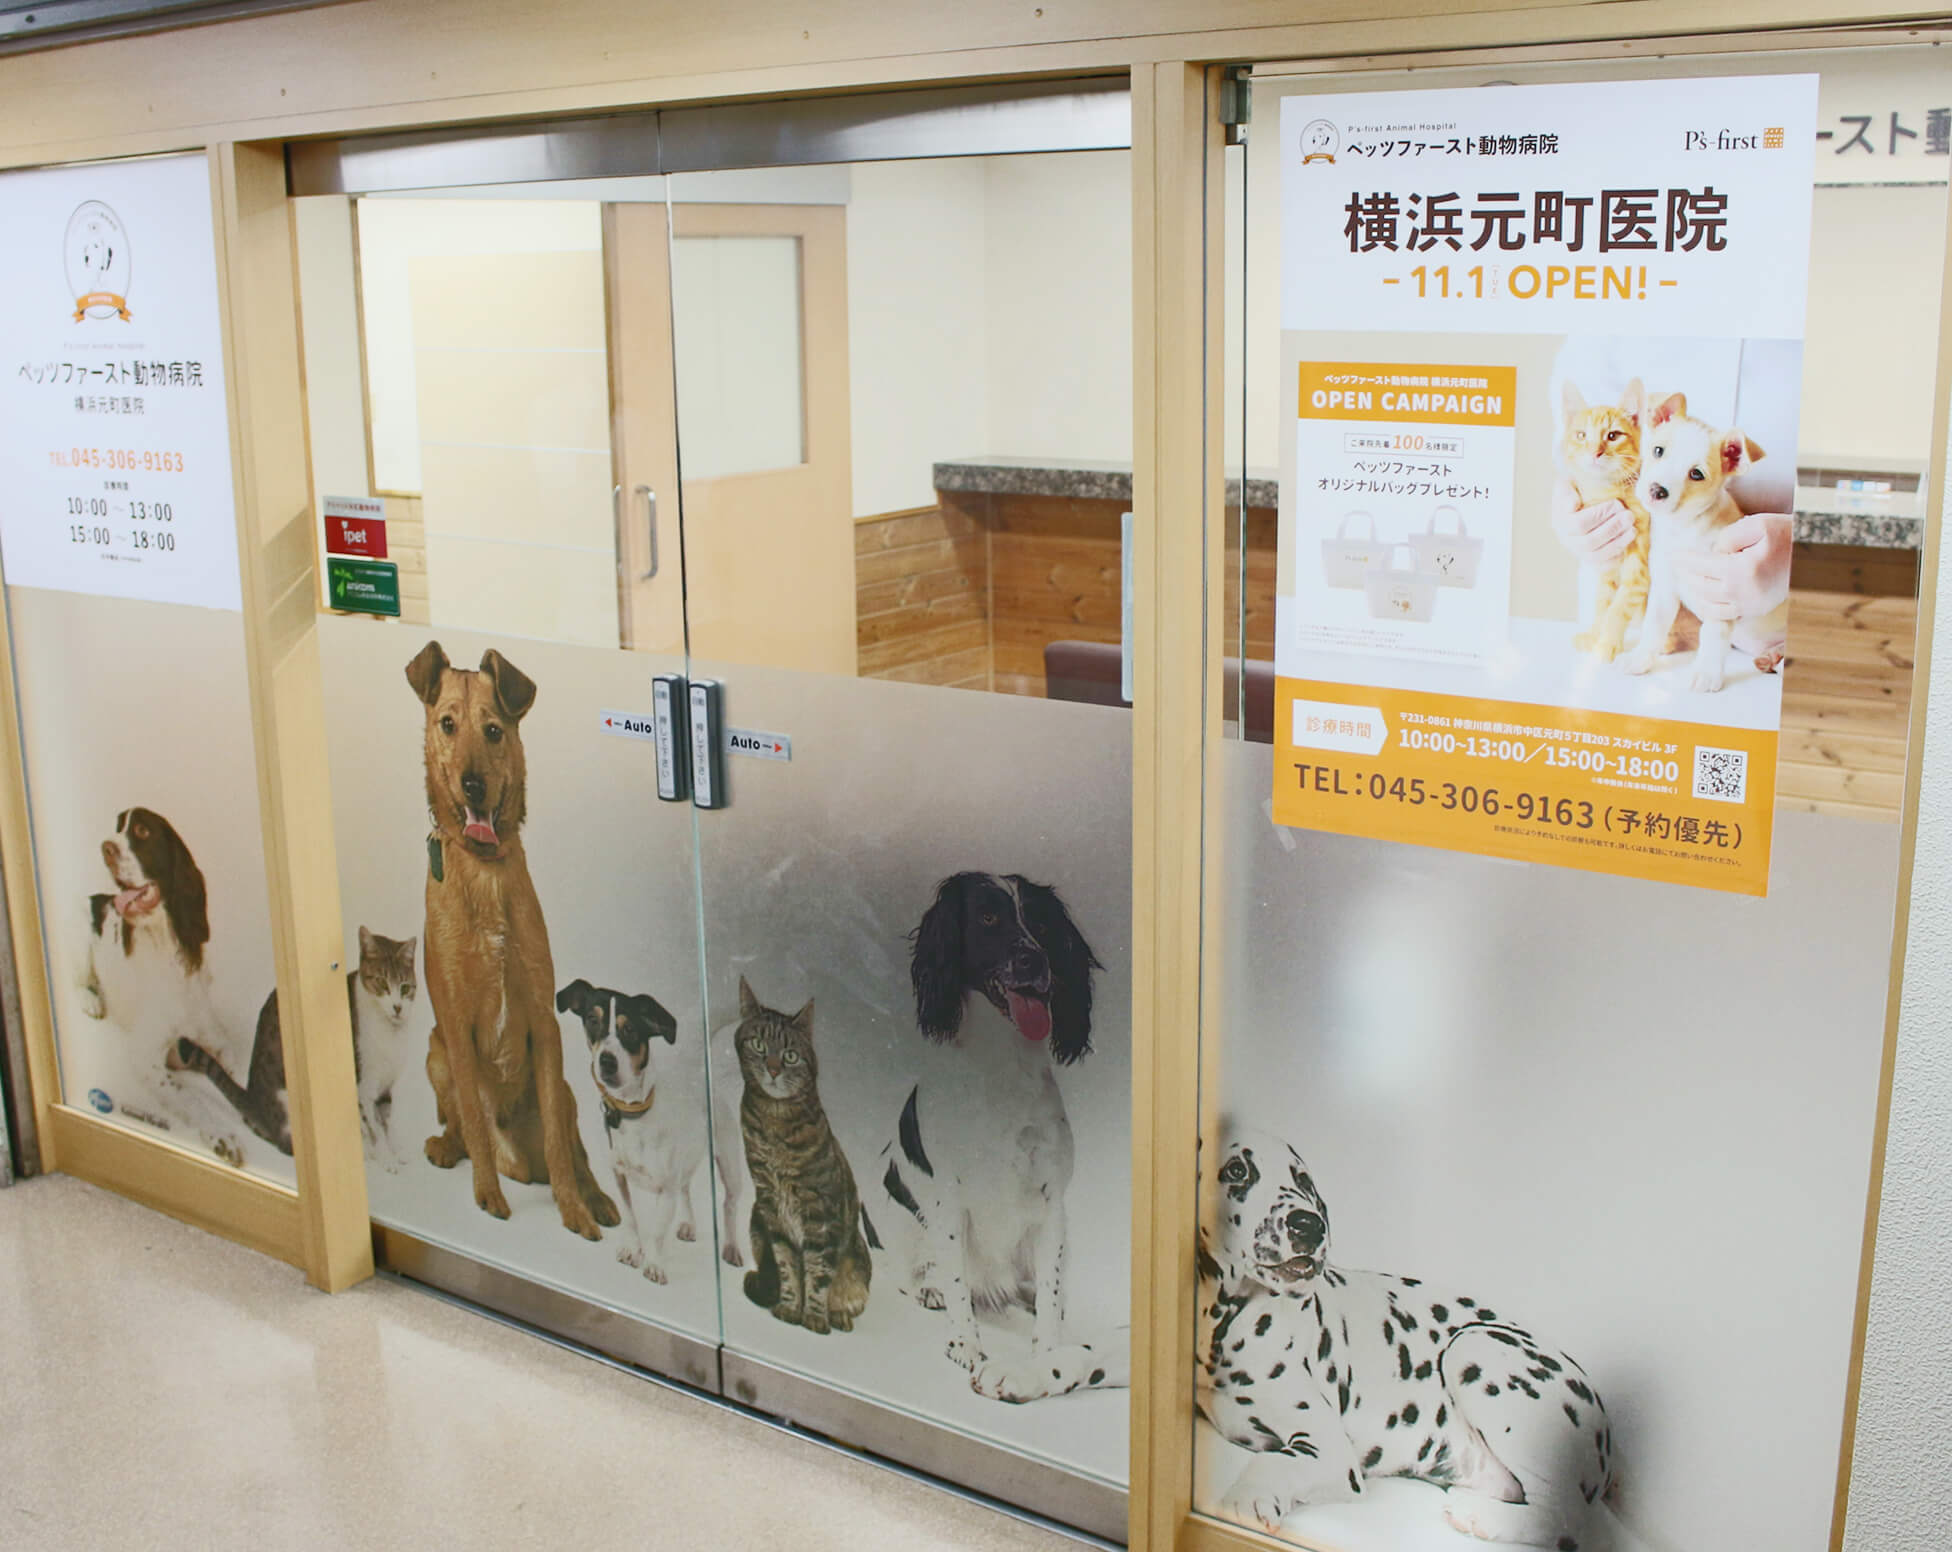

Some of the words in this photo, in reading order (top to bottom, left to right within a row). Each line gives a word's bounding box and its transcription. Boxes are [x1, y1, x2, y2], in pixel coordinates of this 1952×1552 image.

[1386, 124, 1416, 132] Animal
[1419, 122, 1457, 132] Hospital
[1347, 133, 1559, 157] ペッツファースト動物病院
[1684, 129, 1759, 150] P's-first
[1344, 186, 1728, 253] 横浜元町医院
[1410, 265, 1484, 298] 11.1
[1508, 264, 1647, 300] OPEN!
[18, 360, 203, 387] ペッツファースト動物病院
[1311, 390, 1373, 410] OPEN
[1381, 392, 1503, 415] CAMPAIGN
[1353, 460, 1452, 477] ペッツファースト
[68, 496, 107, 517] 10:00
[129, 501, 172, 522] 13:00
[70, 525, 110, 545] 15:00
[132, 530, 175, 551] 18:00
[624, 719, 652, 734] Auto
[1306, 715, 1372, 739] 診療時間
[730, 735, 761, 750] Auto
[1612, 736, 1662, 754] スカイビル
[1664, 743, 1678, 755] 3F
